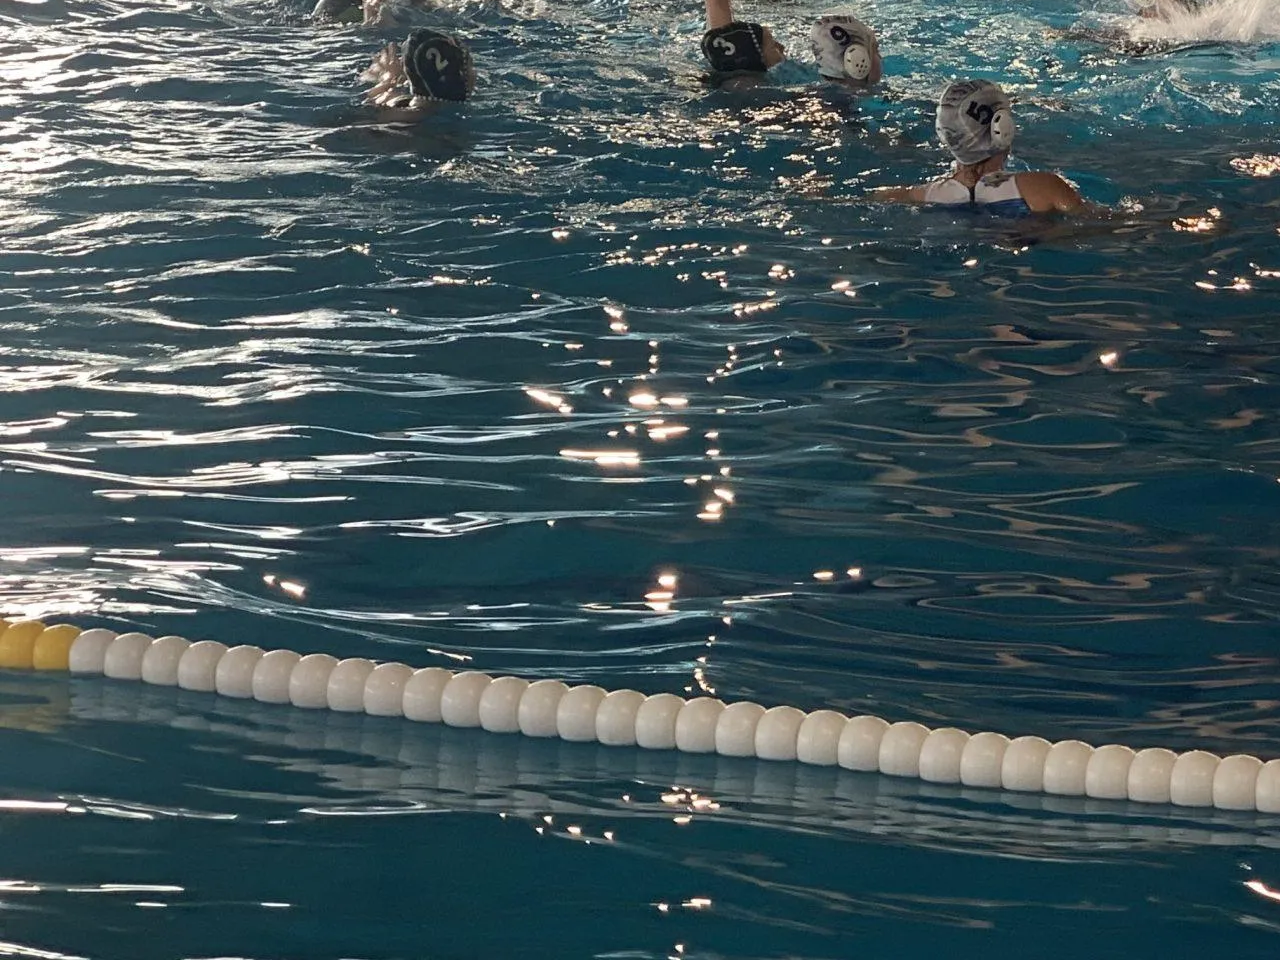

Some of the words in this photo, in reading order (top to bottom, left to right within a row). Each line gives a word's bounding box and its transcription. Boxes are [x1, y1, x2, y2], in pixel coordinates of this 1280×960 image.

[712, 36, 736, 56] 3
[425, 47, 449, 72] 2
[966, 100, 994, 126] 5
